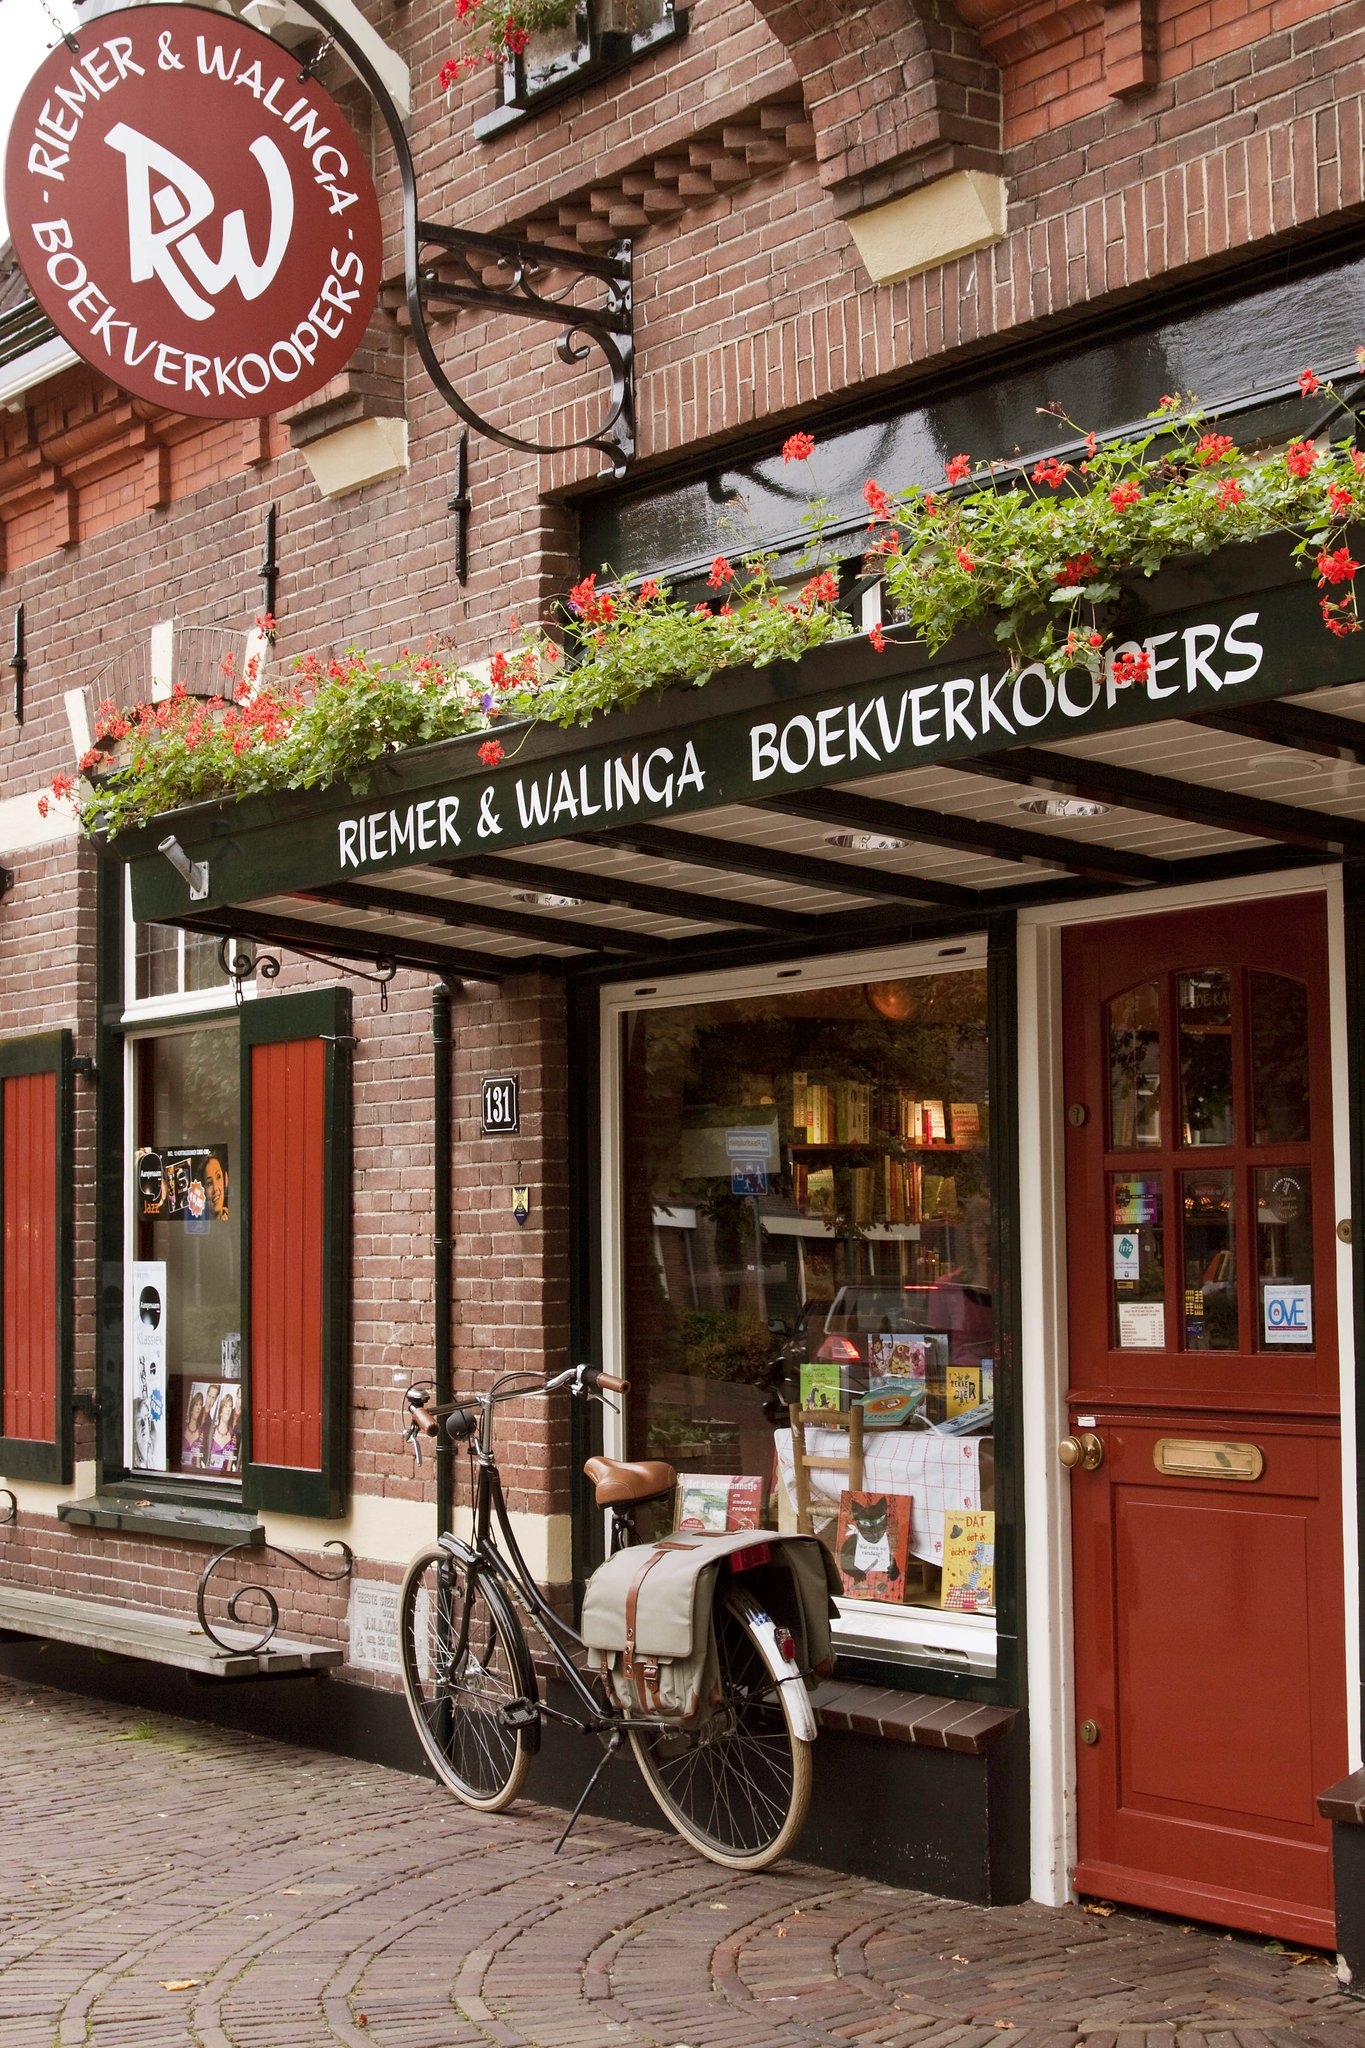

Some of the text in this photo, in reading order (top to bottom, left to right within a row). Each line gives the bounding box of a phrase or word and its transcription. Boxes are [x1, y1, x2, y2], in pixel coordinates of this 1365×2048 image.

[28, 30, 359, 216] RIEMER & WALINGA
[32, 217, 364, 399] BOEKVERKOOPERS
[338, 612, 1263, 868] RIEMER & WALINGA BOEKVERKOOPERS
[486, 1087, 511, 1123] 131
[144, 1200, 160, 1214] Jazz
[1120, 1242, 1132, 1252] iris
[1268, 1298, 1305, 1325] OVE
[966, 1515, 986, 1528] DAT
